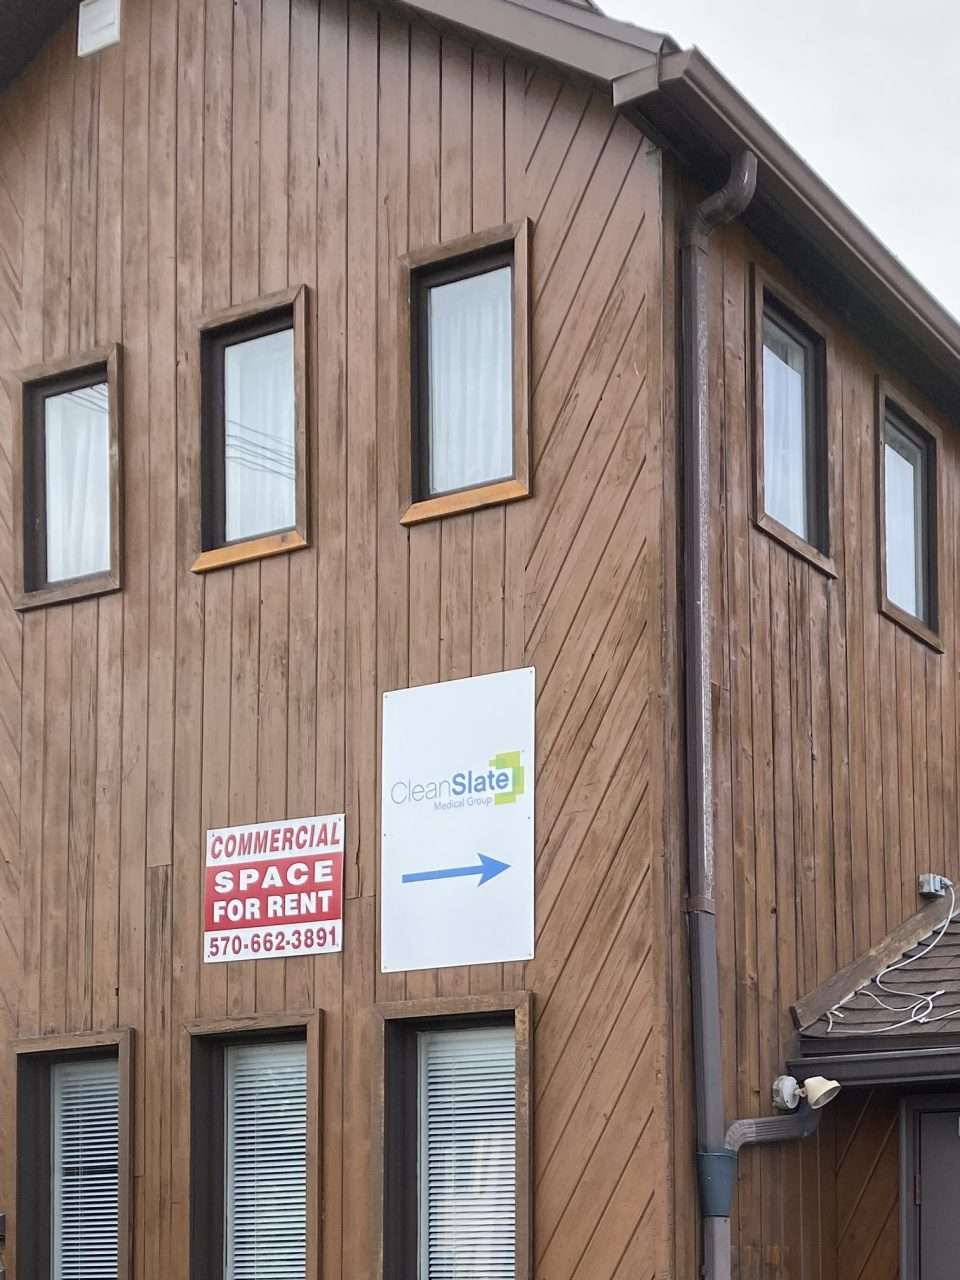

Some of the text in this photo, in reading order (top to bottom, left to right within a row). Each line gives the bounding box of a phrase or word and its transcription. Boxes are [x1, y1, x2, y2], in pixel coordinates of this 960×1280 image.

[390, 769, 509, 804] CleanSlate
[434, 796, 492, 811] Medical Group
[211, 822, 340, 859] COMMERCIAL
[214, 860, 333, 893] SPACE
[213, 890, 333, 923] FOR RENT
[209, 926, 336, 956] 570-662-3891
